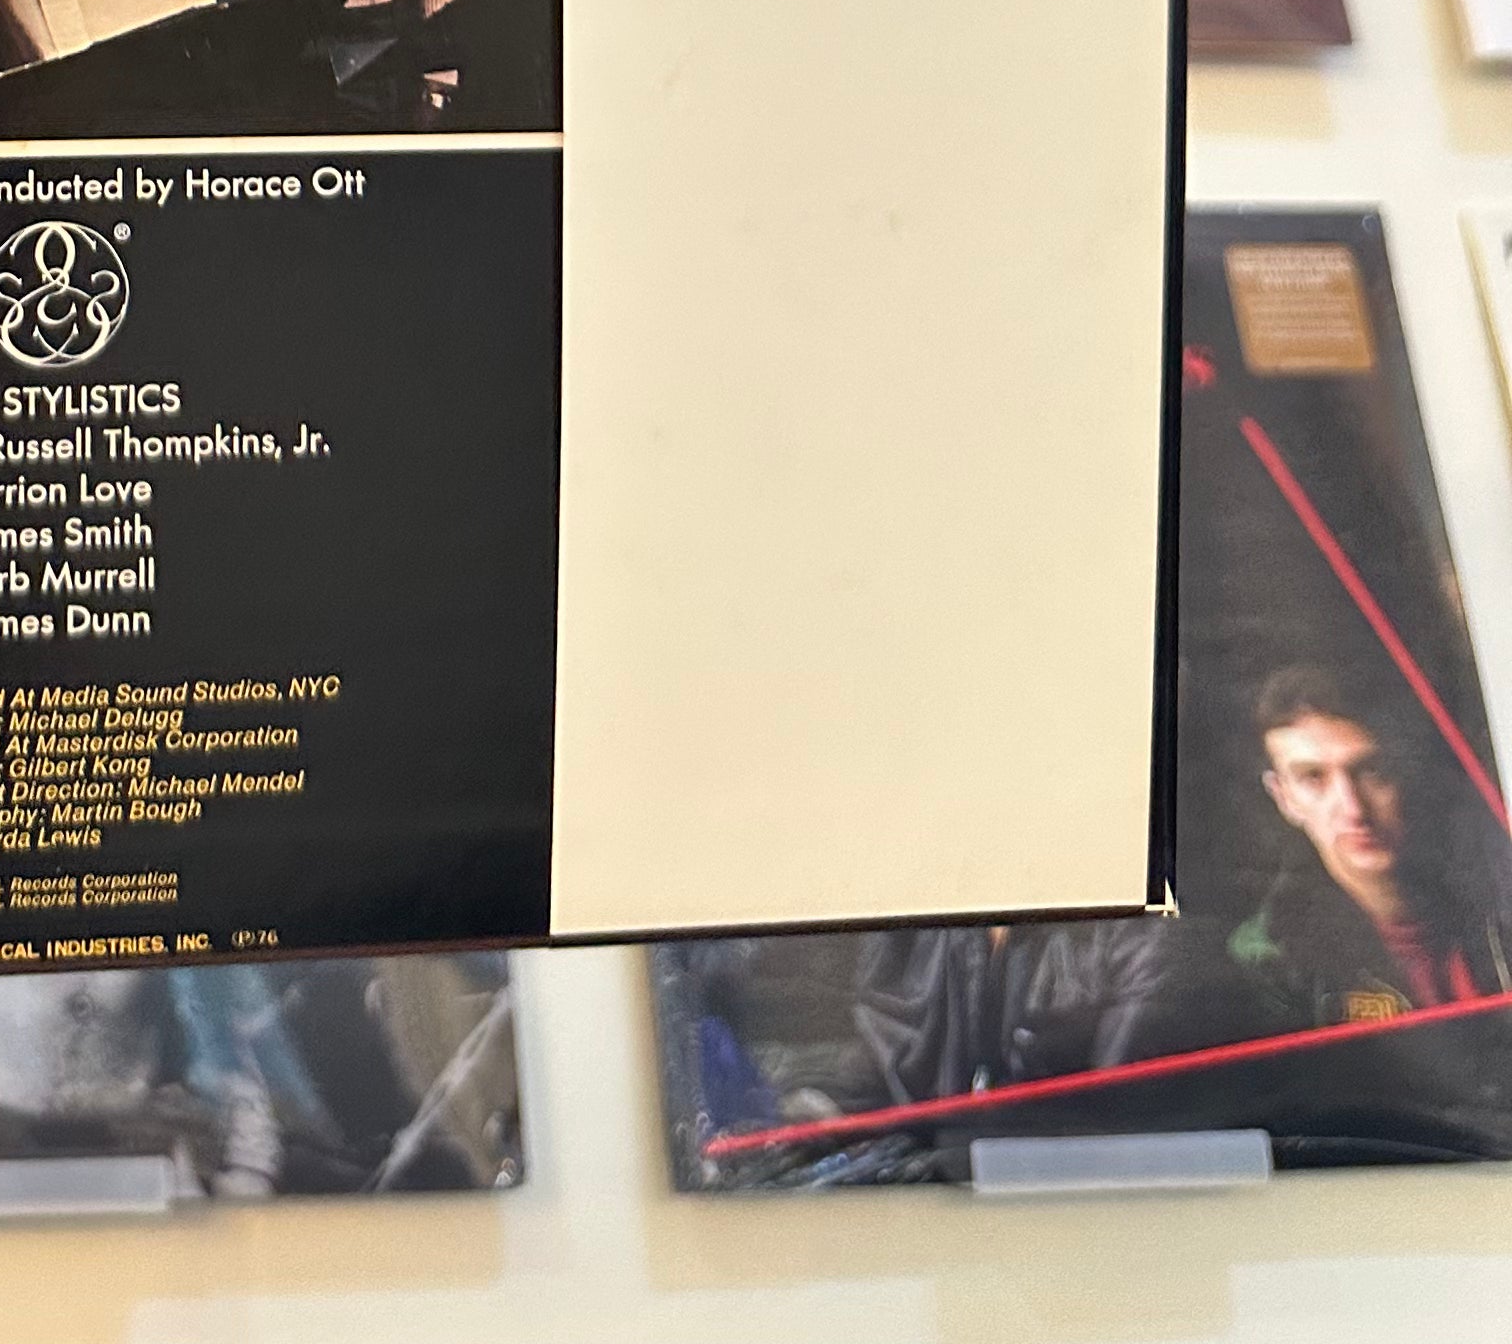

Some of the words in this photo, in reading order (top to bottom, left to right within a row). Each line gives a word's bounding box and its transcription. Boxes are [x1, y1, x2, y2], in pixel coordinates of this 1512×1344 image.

[136, 168, 174, 208] by
[186, 168, 302, 200] Horace
[312, 166, 366, 198] Ott
[3, 383, 181, 419] STYLISTICS
[102, 423, 282, 465] Thompkins,
[292, 423, 330, 456] Jr.
[80, 473, 153, 505] Love
[64, 512, 153, 549] Smith
[40, 556, 155, 593] Murrell
[66, 604, 151, 637] Dunn
[9, 687, 35, 710] At
[40, 685, 110, 708] Media
[115, 681, 189, 706] Sound
[288, 675, 341, 698] NYC
[8, 709, 99, 732] Michael
[4, 734, 30, 756] At
[35, 730, 159, 755] Masterdisk
[165, 726, 298, 752] Corporation
[9, 758, 87, 779] Gilbert
[92, 757, 151, 782] Kong
[11, 778, 123, 804] Direction:
[127, 773, 217, 798] Michael
[51, 800, 123, 825] Martin
[129, 797, 202, 824] Bough
[37, 825, 102, 849] Lewis
